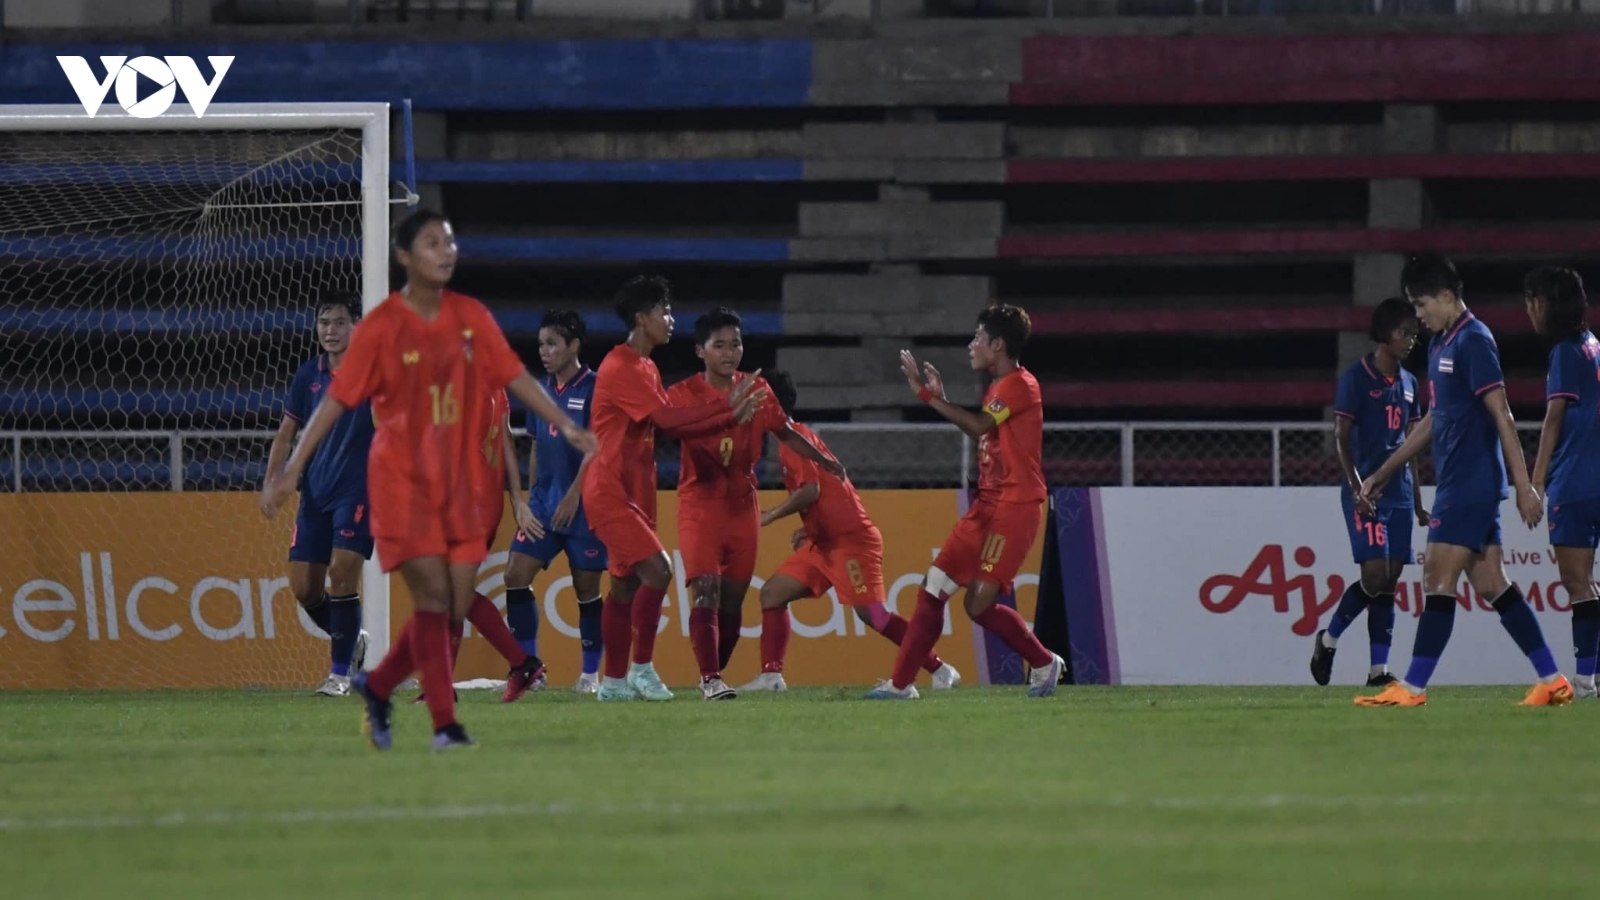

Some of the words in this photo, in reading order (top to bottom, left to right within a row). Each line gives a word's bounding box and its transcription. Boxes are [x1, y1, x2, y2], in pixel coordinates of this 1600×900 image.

[429, 383, 460, 426] 16
[1385, 404, 1402, 431] 16
[720, 437, 733, 467] 9
[980, 532, 1007, 565] 10
[1364, 521, 1386, 547] 16
[1502, 550, 1541, 565] Live
[0, 551, 333, 643] ellcar
